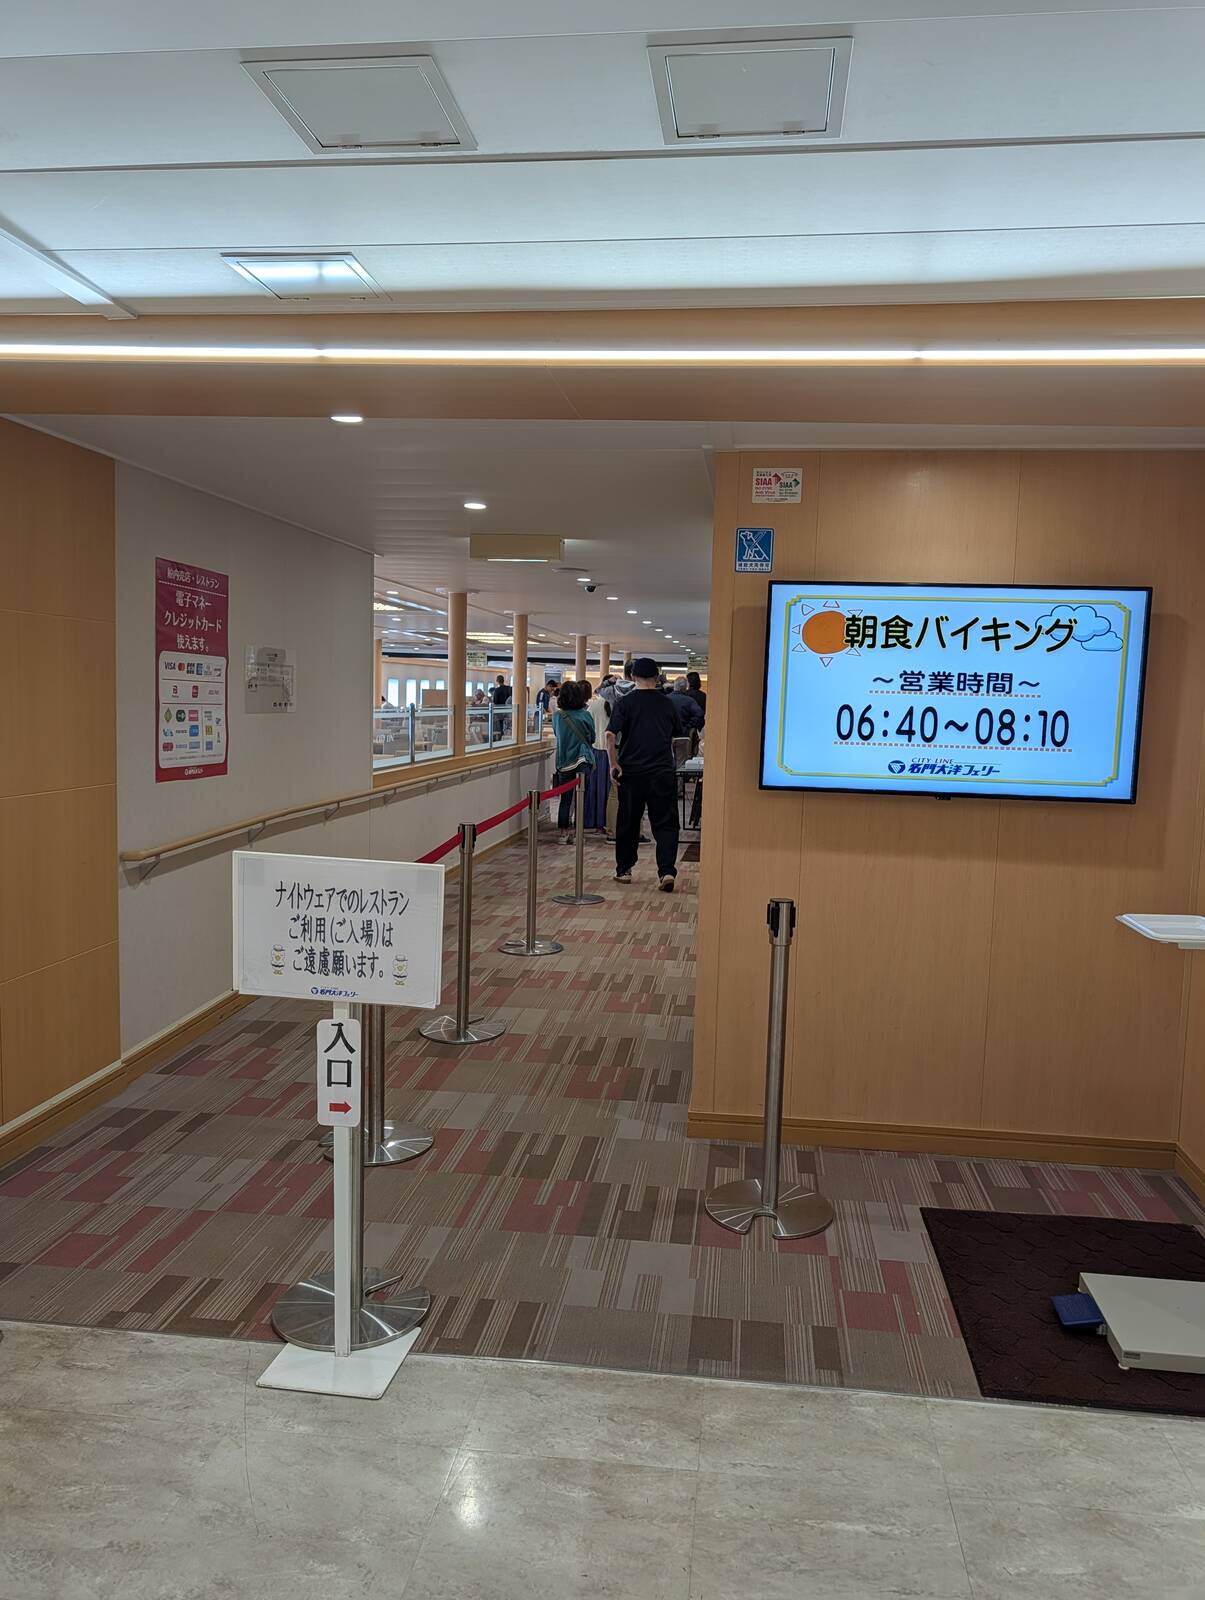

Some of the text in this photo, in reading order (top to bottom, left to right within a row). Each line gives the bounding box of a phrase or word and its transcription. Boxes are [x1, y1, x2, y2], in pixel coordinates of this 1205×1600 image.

[175, 590, 212, 610] 電子マネー
[163, 610, 223, 633] クレジットカード
[844, 615, 1078, 653] 朝食バイキング
[908, 763, 1001, 777] 名門大洋フェリー
[274, 881, 410, 916] ナイトウェアでのレストラン
[293, 946, 384, 979] ご遠慮願います。
[323, 1021, 356, 1088] 入口
